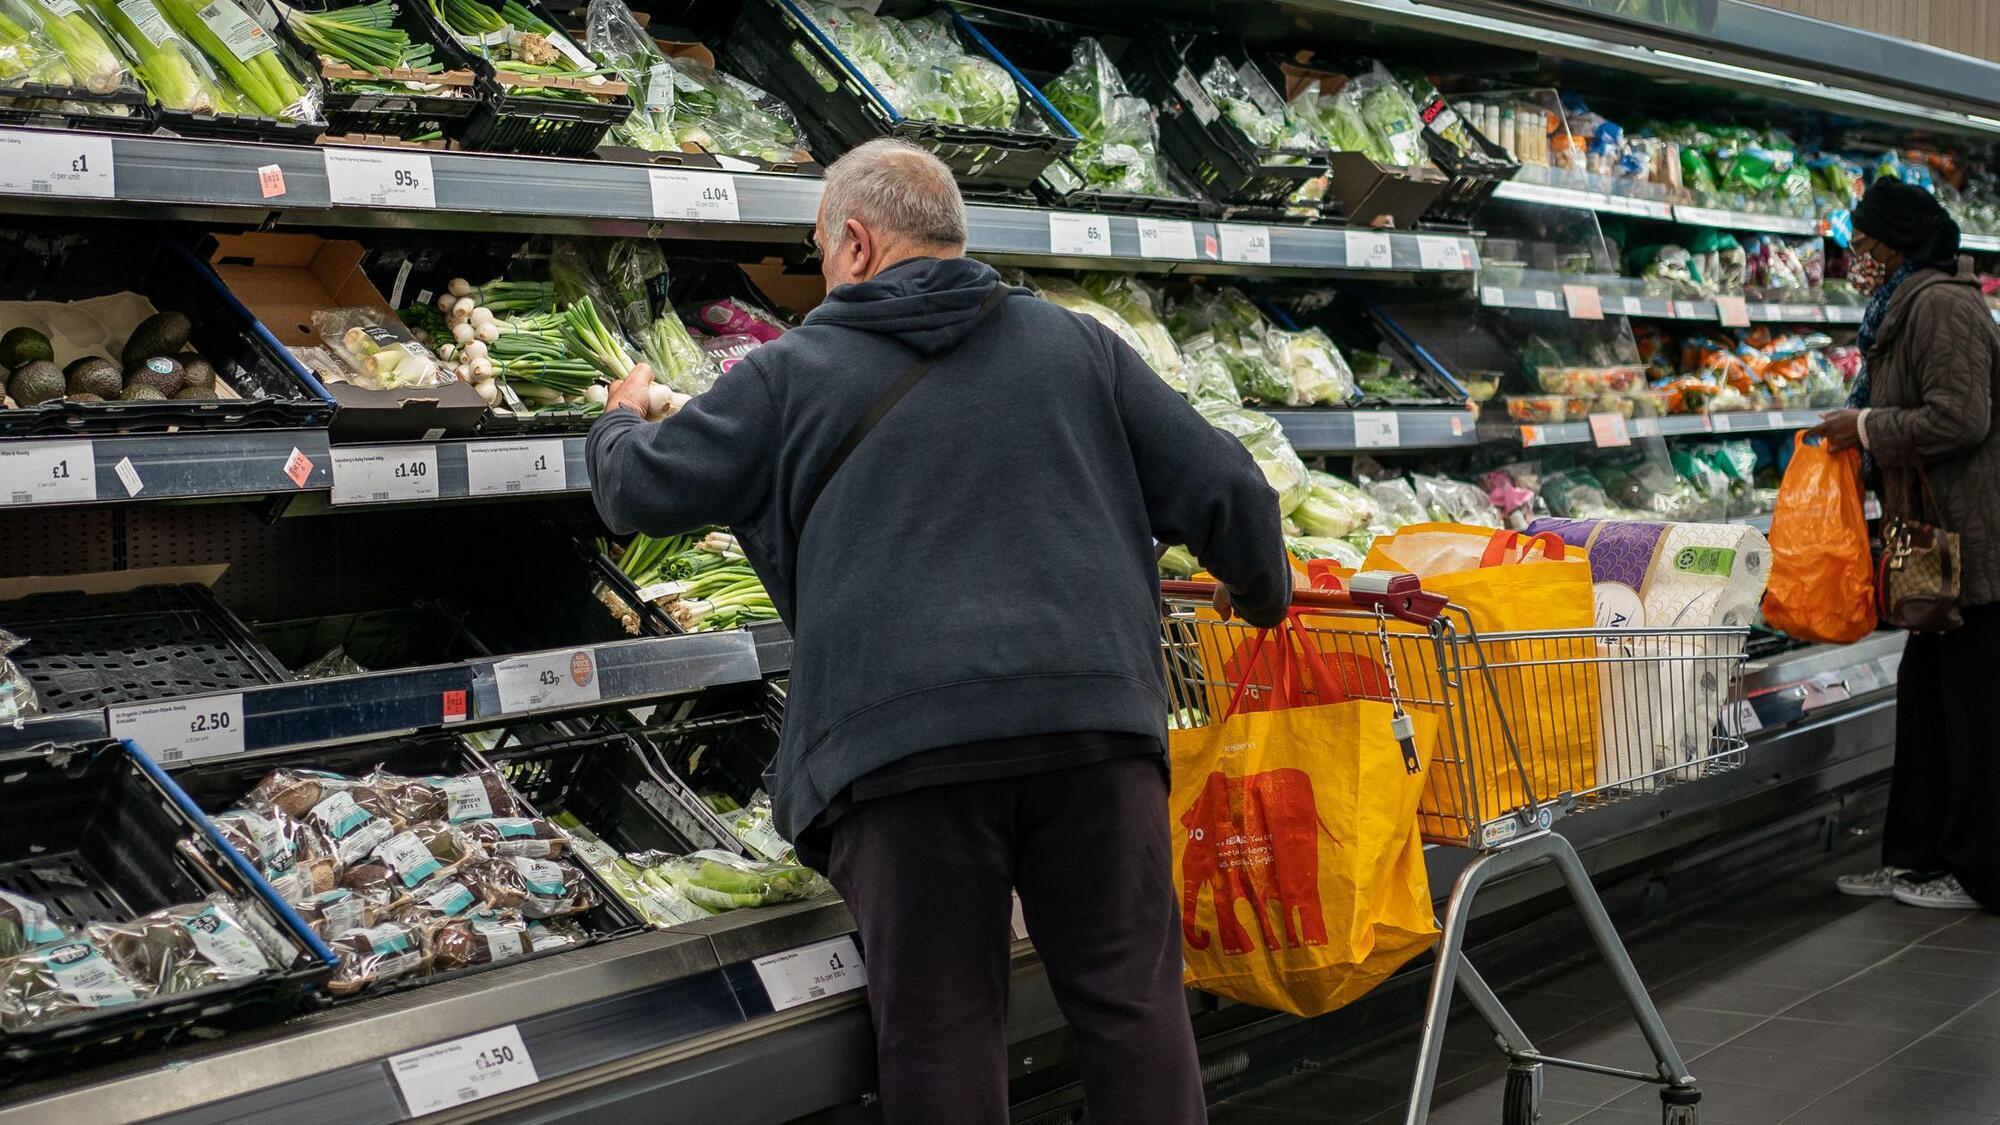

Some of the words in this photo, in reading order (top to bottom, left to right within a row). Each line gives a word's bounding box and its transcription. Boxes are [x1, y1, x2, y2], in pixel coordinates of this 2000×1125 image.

[72, 154, 88, 172] £1
[394, 169, 419, 189] 95p
[702, 187, 729, 201] £1.04
[1142, 228, 1158, 239] INFO
[52, 460, 69, 478] £1
[394, 461, 426, 477] £1.40
[534, 454, 547, 470] £1
[539, 670, 560, 686] 43p
[190, 711, 231, 733] £2.50
[829, 952, 844, 970] £1
[475, 1046, 514, 1070] £1.50
